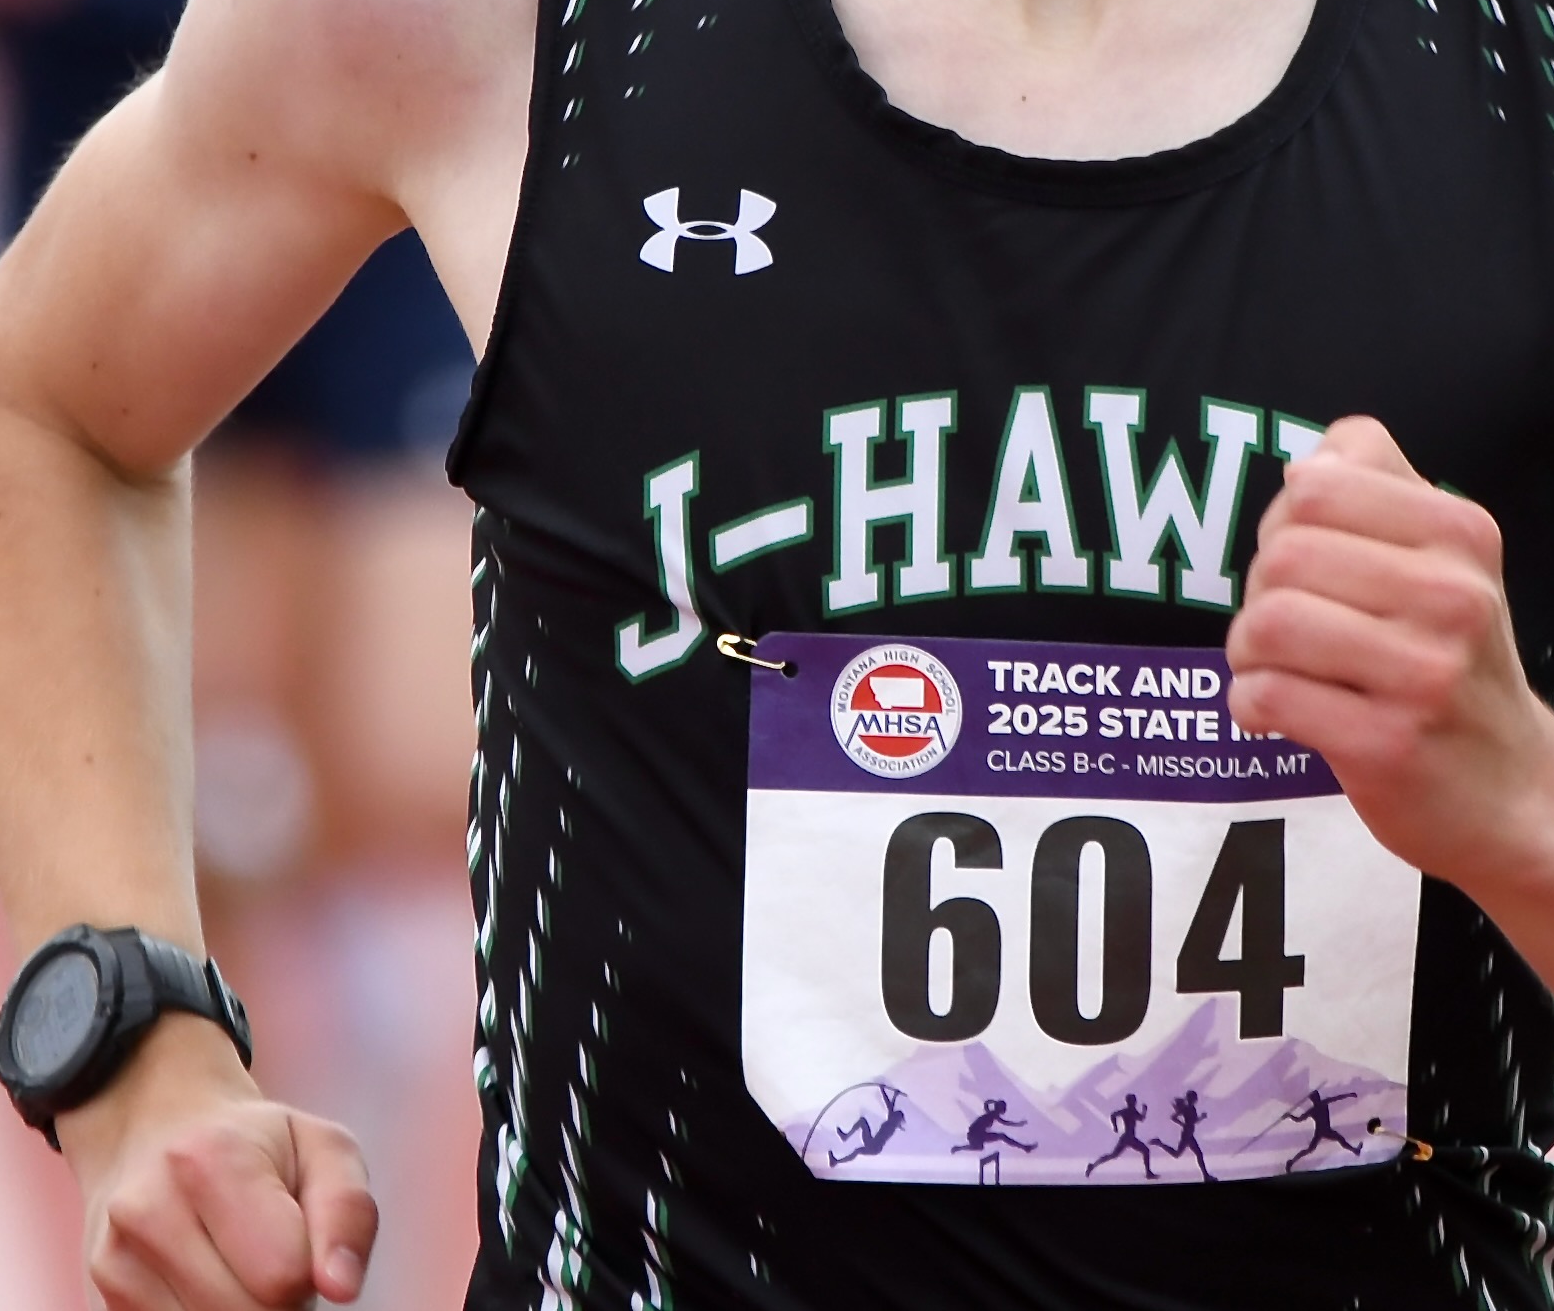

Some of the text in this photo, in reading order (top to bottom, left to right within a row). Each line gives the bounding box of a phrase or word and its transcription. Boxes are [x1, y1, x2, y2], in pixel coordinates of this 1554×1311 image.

[614, 386, 1330, 683] J-HAW
[837, 650, 956, 716] MONTANA HIGH SCHOOL
[987, 660, 1220, 699] TRACK AND
[845, 713, 947, 751] MHSA
[987, 703, 1089, 737] 2025
[1098, 707, 1219, 741] STATE
[853, 746, 938, 771] ASSOCIATION
[986, 749, 1066, 773] CLASS
[1073, 752, 1115, 774] B-C
[1136, 754, 1269, 779] MISSOULA,
[1276, 753, 1311, 775] MT
[880, 811, 1306, 1046] 604
